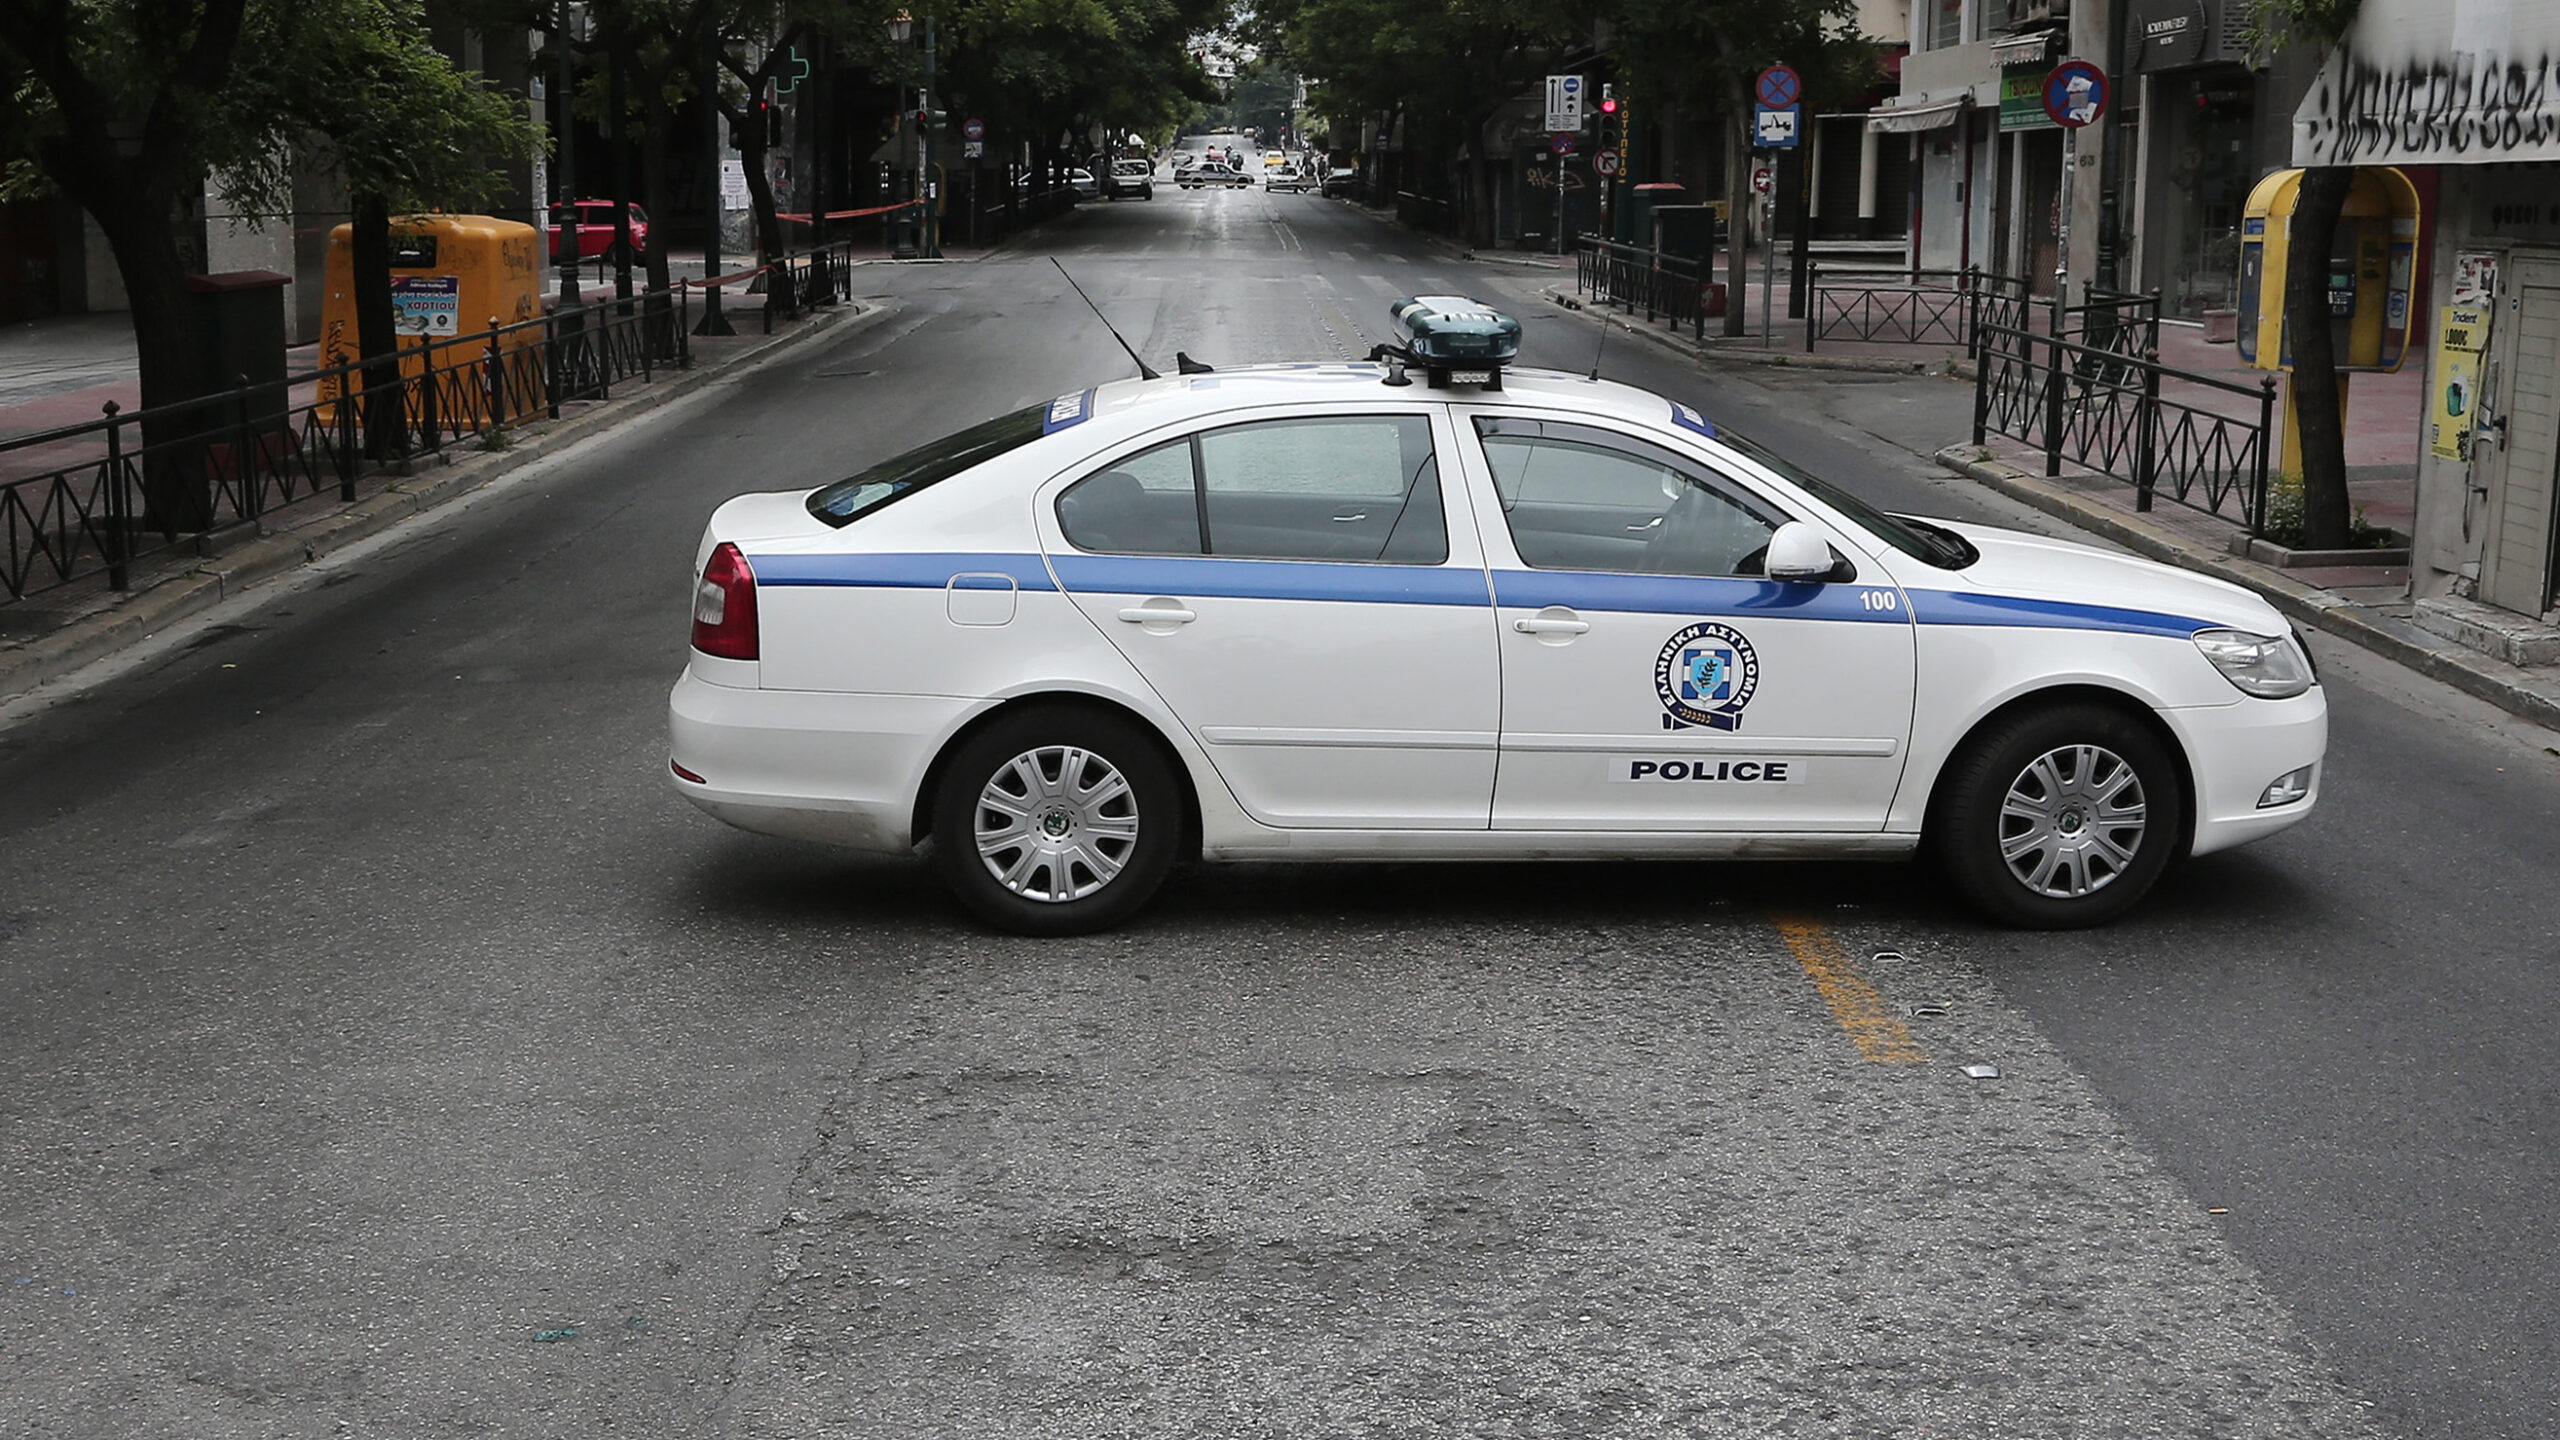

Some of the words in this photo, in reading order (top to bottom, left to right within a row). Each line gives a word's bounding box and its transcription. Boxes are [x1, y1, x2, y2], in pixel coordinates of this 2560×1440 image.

[1859, 590, 1896, 611] 100
[1657, 626, 1700, 708] ΕΛΛΗΝΙΚΗ
[1705, 625, 1758, 708] ΑΣΤΥΝΟΜΙΑ
[1629, 760, 1789, 782] POLICE
